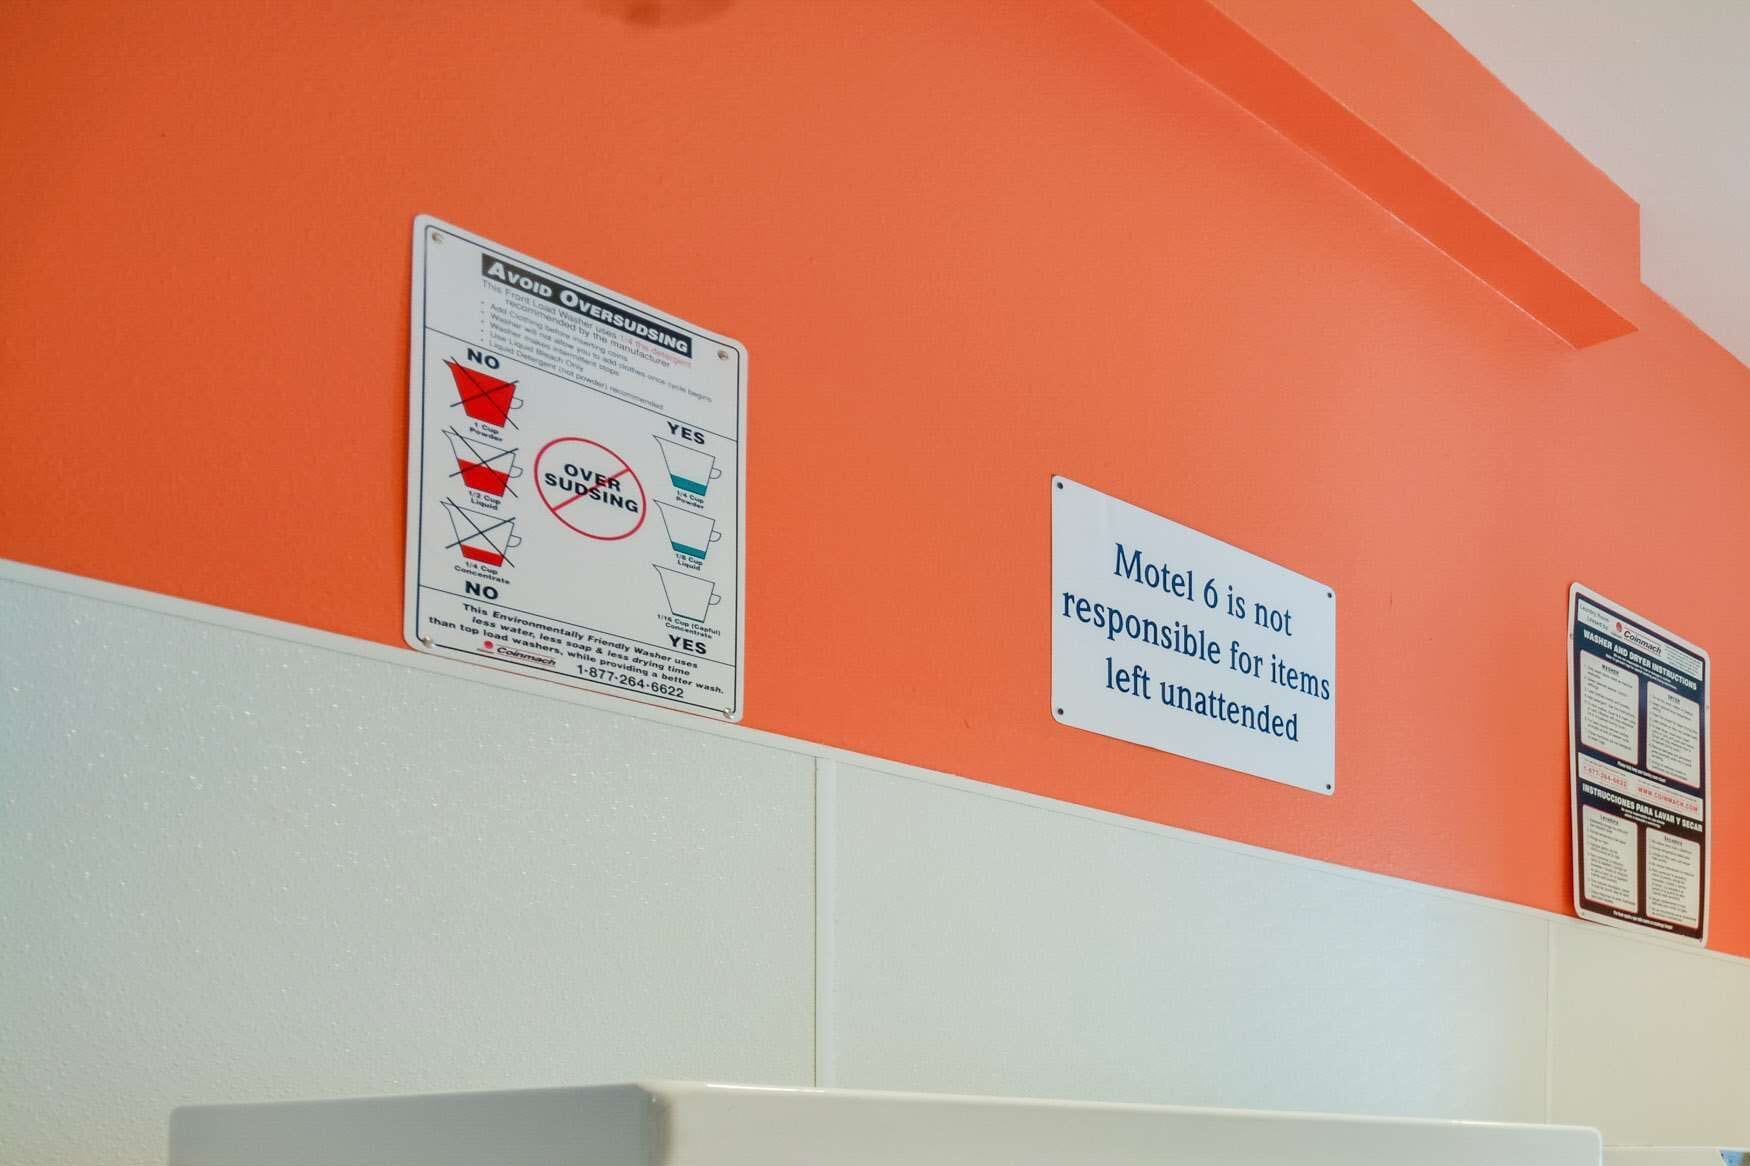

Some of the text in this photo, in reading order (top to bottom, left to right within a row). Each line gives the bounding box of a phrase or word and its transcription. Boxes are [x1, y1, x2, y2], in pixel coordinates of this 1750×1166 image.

[504, 287, 526, 305] Front
[530, 297, 556, 316] Load
[558, 308, 593, 330] Washer
[595, 323, 617, 340] uses
[504, 296, 576, 332] recommended
[578, 325, 590, 339] by
[592, 331, 607, 344] the
[467, 348, 500, 370] NO
[469, 426, 503, 442] Powder
[482, 423, 499, 435] Cup
[667, 421, 705, 445] YES
[564, 463, 620, 492] OVER
[470, 497, 499, 511] Liquid
[483, 495, 501, 506] Cup
[544, 472, 639, 514] SUDSING
[689, 494, 705, 504] Cup
[480, 564, 499, 576] Cup
[677, 558, 702, 572] Liquid
[688, 556, 703, 567] Cup
[454, 565, 511, 585] Concentrate
[465, 581, 499, 600] NO
[1113, 542, 1293, 637] Motel 6 is not
[665, 622, 713, 639] Concentrate
[674, 618, 690, 628] Cup
[462, 603, 698, 669] This Environmentally Friendly Washer uses
[472, 616, 690, 676] less water, less soap & less drying time
[668, 634, 707, 655] YES
[1062, 591, 1331, 700] responsible for items
[1623, 630, 1662, 655] Coinmach
[428, 616, 456, 629] than
[460, 624, 479, 636] top
[483, 629, 508, 642] load
[567, 651, 597, 663] while
[600, 658, 649, 677] providing
[661, 672, 693, 687] better
[695, 682, 724, 695] wash.
[1583, 629, 1613, 650] WASHER
[1613, 644, 1629, 657] AND
[1629, 650, 1652, 668] DRYER
[1651, 663, 1697, 691] INSTRUCTIONS
[497, 647, 684, 699] Coinmach 1-877-264-6622
[1105, 656, 1299, 743] left unattended
[1582, 782, 1635, 811] INSTRUCCIONES
[1635, 803, 1654, 818] PARA
[1654, 809, 1675, 824] LAVAR
[1682, 819, 1703, 833] SECAR
